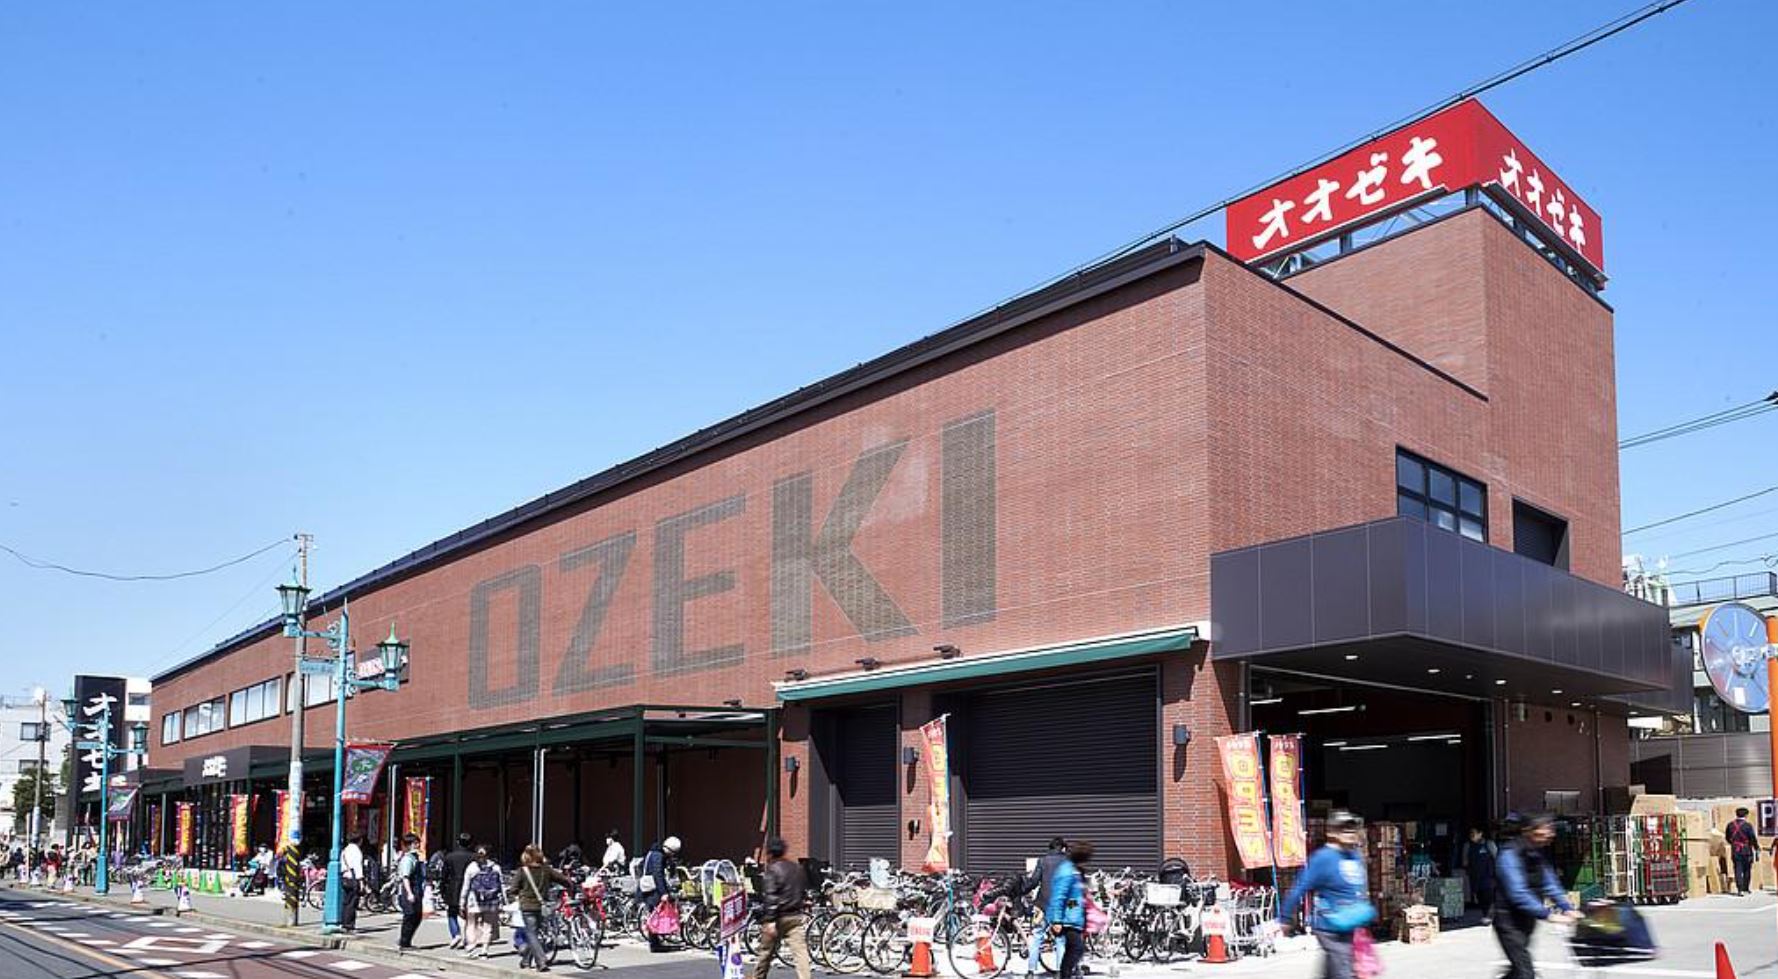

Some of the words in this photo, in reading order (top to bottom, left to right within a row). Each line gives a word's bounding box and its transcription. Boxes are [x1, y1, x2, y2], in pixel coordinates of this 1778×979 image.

[1252, 136, 1443, 249] オオゼキ
[1500, 147, 1586, 253] オオゼキ
[468, 410, 997, 709] OZEKI
[1761, 803, 1774, 828] P
